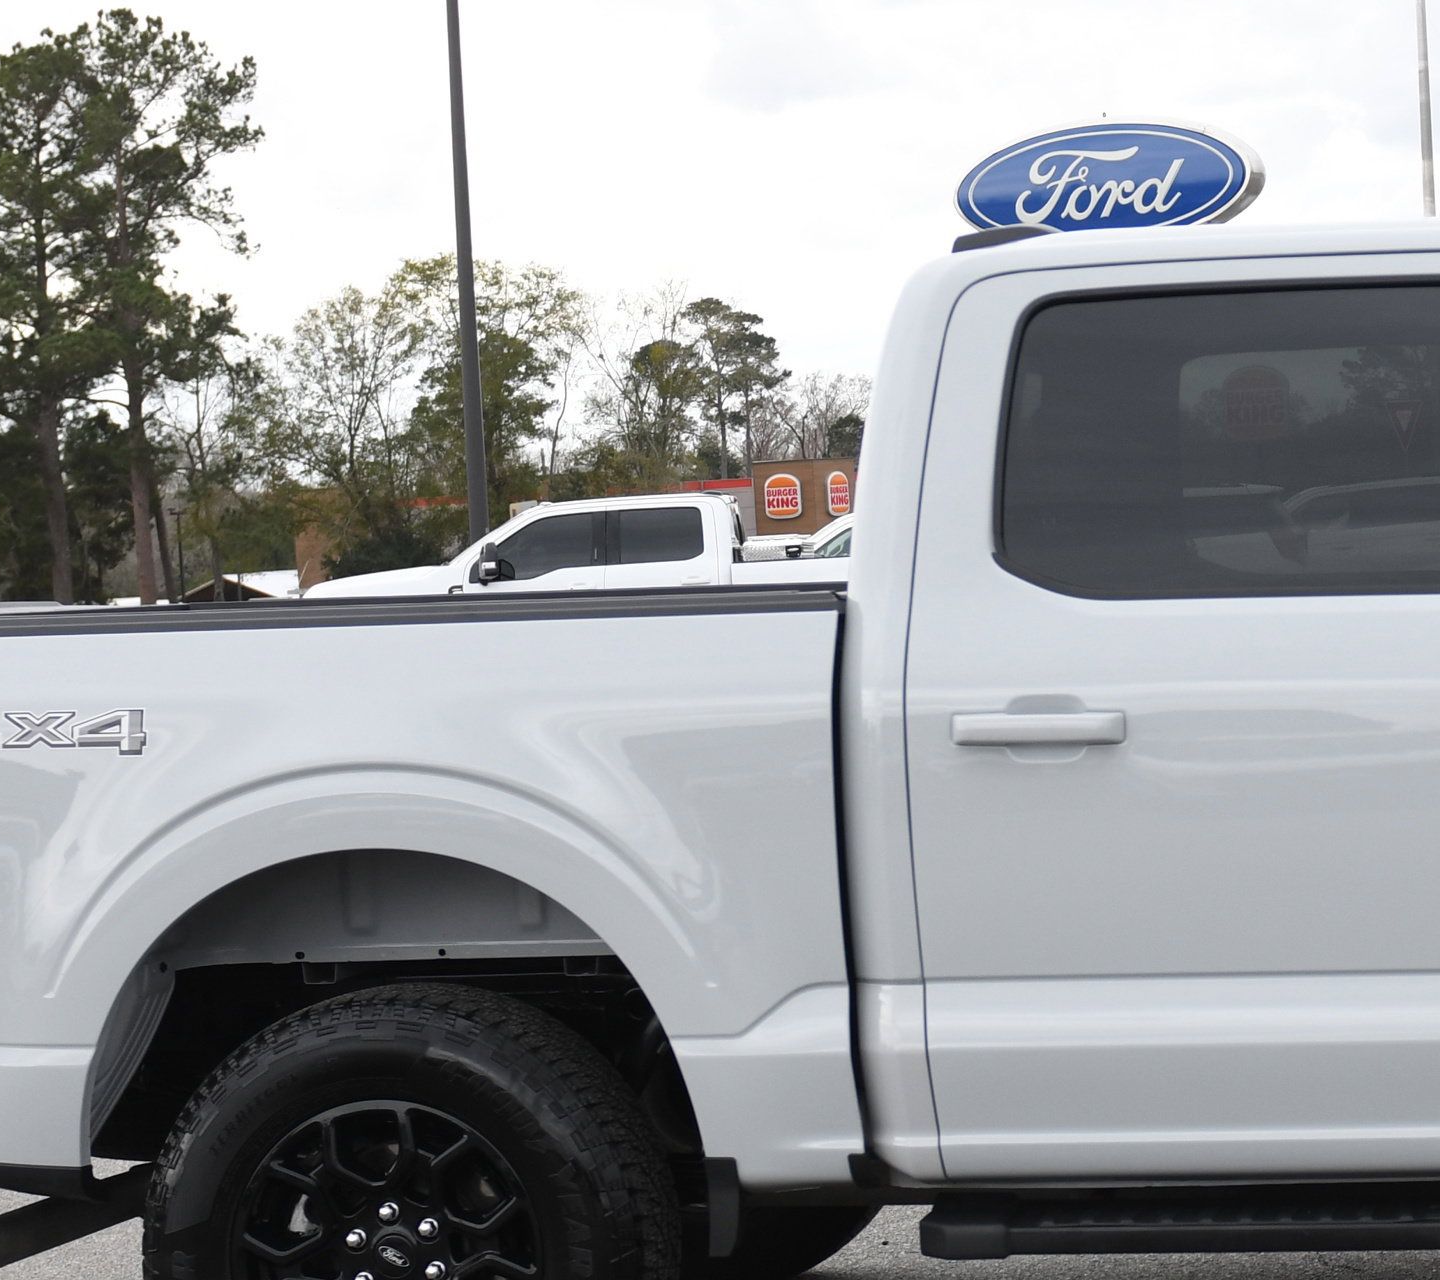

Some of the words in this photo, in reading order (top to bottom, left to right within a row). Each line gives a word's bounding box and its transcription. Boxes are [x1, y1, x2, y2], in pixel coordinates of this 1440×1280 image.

[1015, 145, 1184, 224] Ford
[766, 488, 798, 497] BURGER
[830, 486, 848, 494] BURGER
[767, 497, 798, 508] KING
[830, 494, 849, 506] KING
[382, 1248, 405, 1265] Ford
